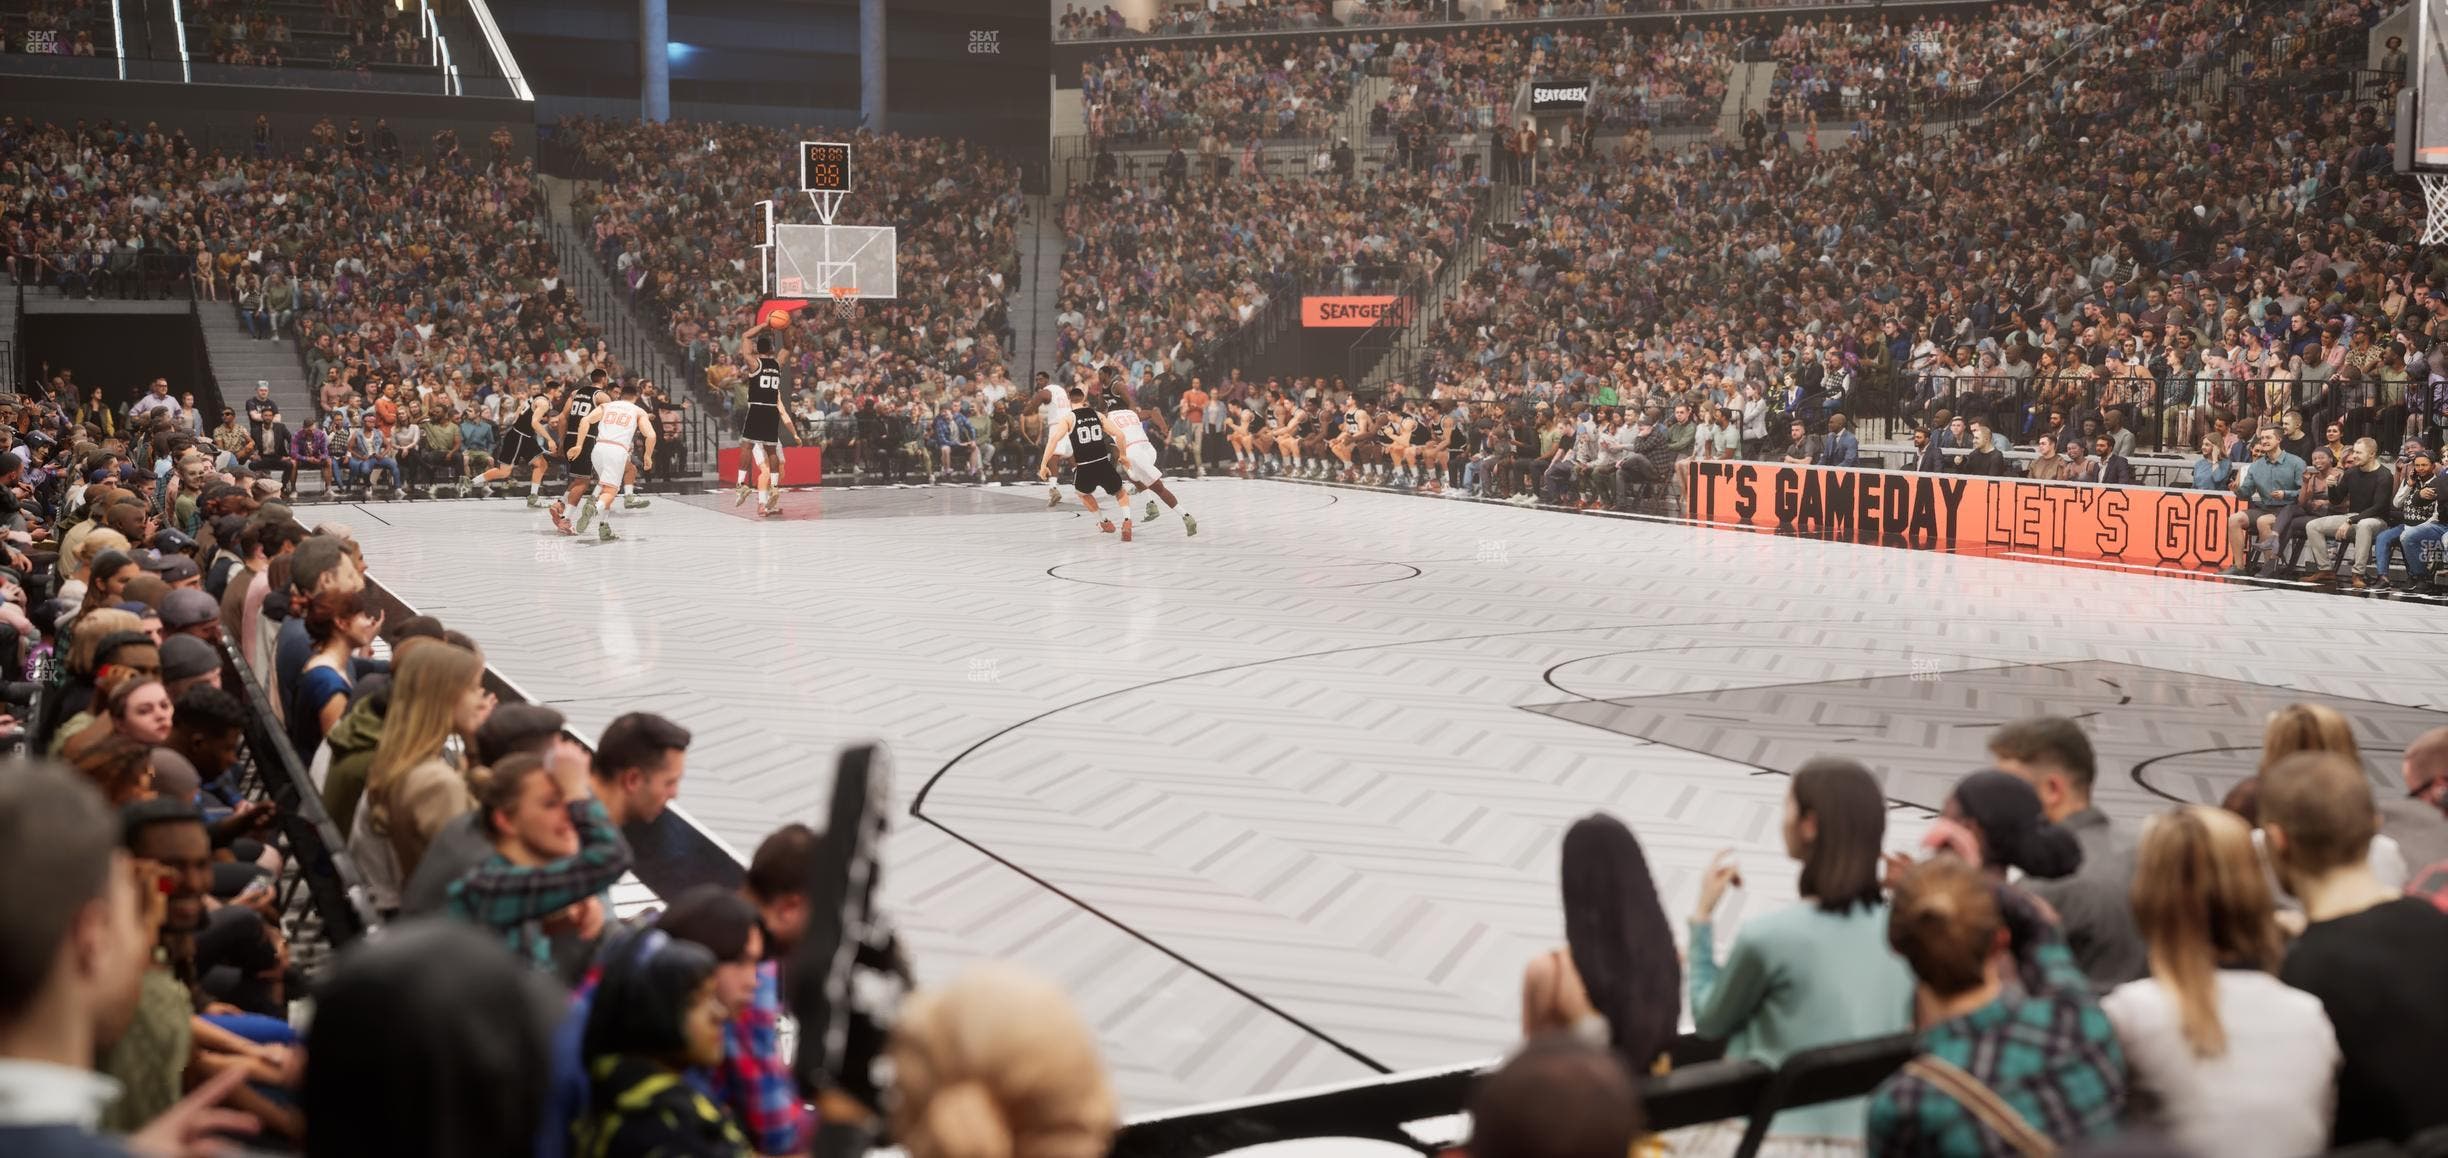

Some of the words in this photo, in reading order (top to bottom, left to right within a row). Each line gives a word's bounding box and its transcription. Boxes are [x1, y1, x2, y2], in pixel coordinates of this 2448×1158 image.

[1533, 87, 1588, 103] SEATGEEK
[760, 375, 780, 389] 00
[1077, 424, 1103, 444] 00
[1689, 462, 1758, 519] IT'S
[1775, 467, 1968, 540] GAMEDAY
[1985, 480, 2129, 556] LET'S
